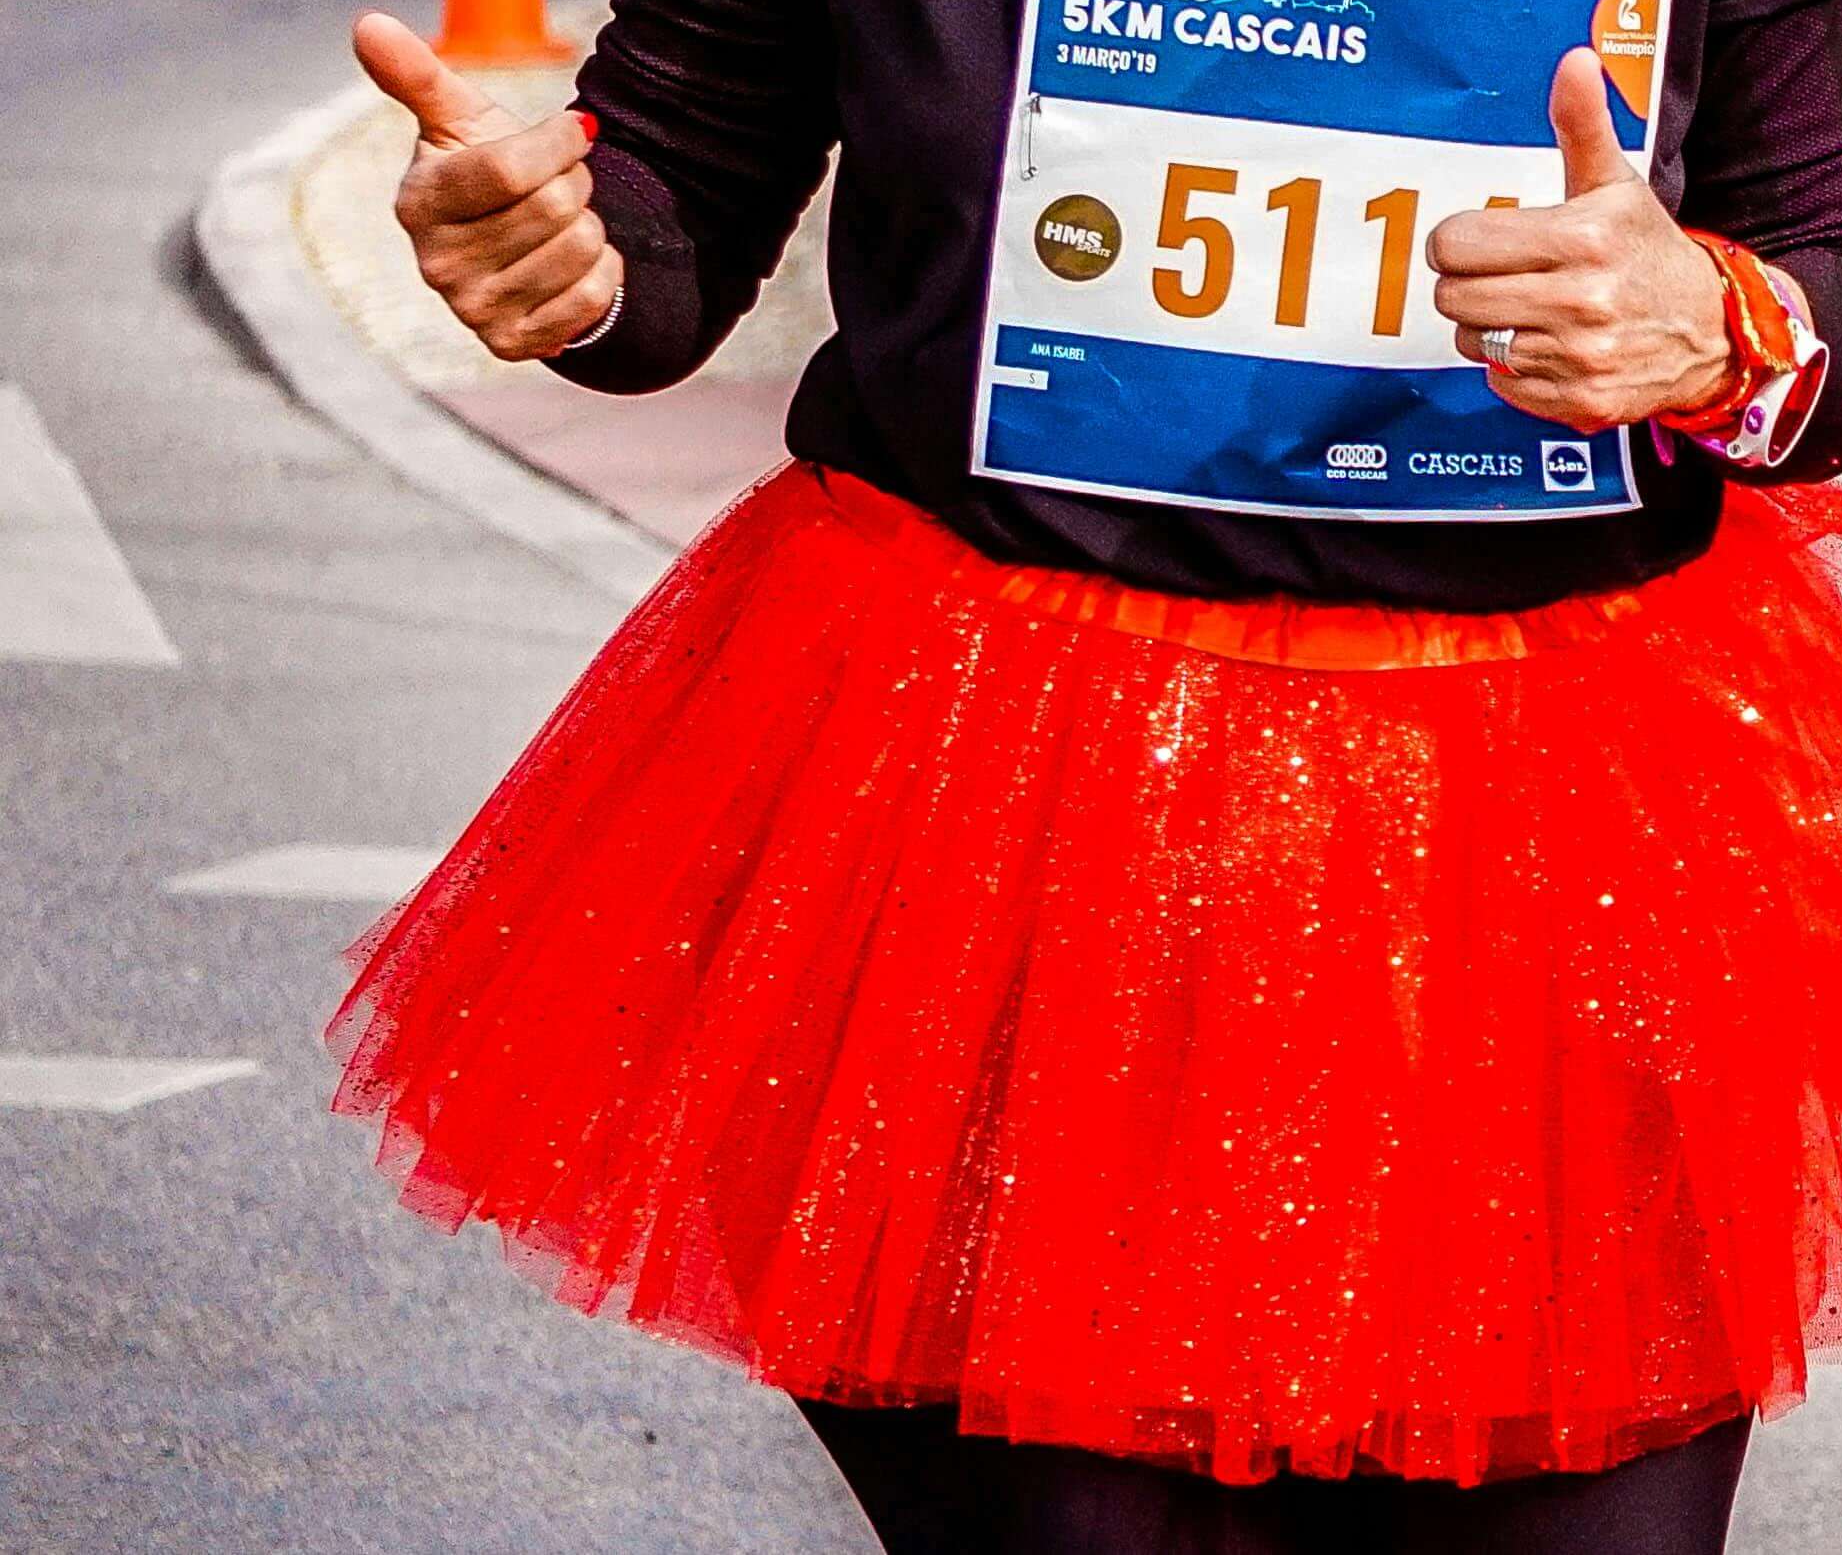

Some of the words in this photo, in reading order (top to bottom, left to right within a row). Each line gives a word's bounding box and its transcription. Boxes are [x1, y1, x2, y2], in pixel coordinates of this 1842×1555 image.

[1173, 8, 1367, 65] CASCAIS
[1057, 43, 1068, 63] 3
[1072, 45, 1157, 75] MARÇO'19
[1043, 221, 1103, 248] HMS
[1151, 162, 1519, 337] 511
[1409, 453, 1523, 476] CASCAIS
